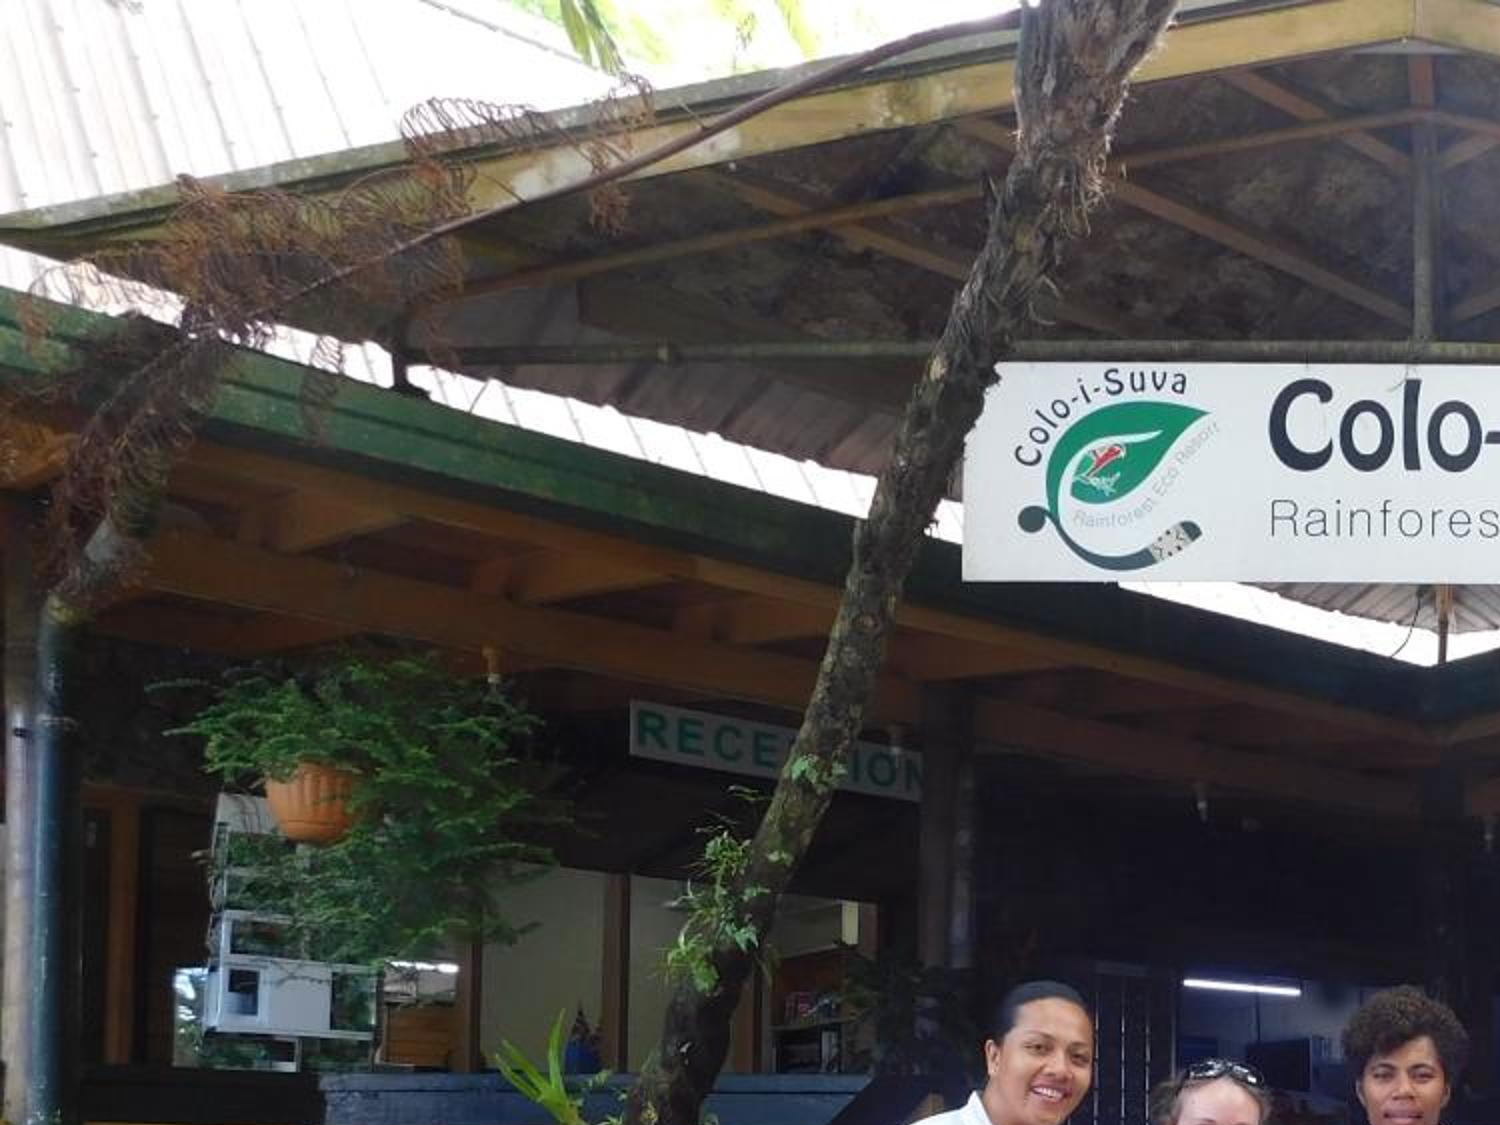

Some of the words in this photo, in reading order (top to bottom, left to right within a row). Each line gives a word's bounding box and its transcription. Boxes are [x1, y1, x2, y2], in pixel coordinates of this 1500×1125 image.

[1014, 367, 1188, 467] Colo-i-Suva
[1151, 466, 1179, 498] Eco
[636, 708, 923, 793] RECEION
